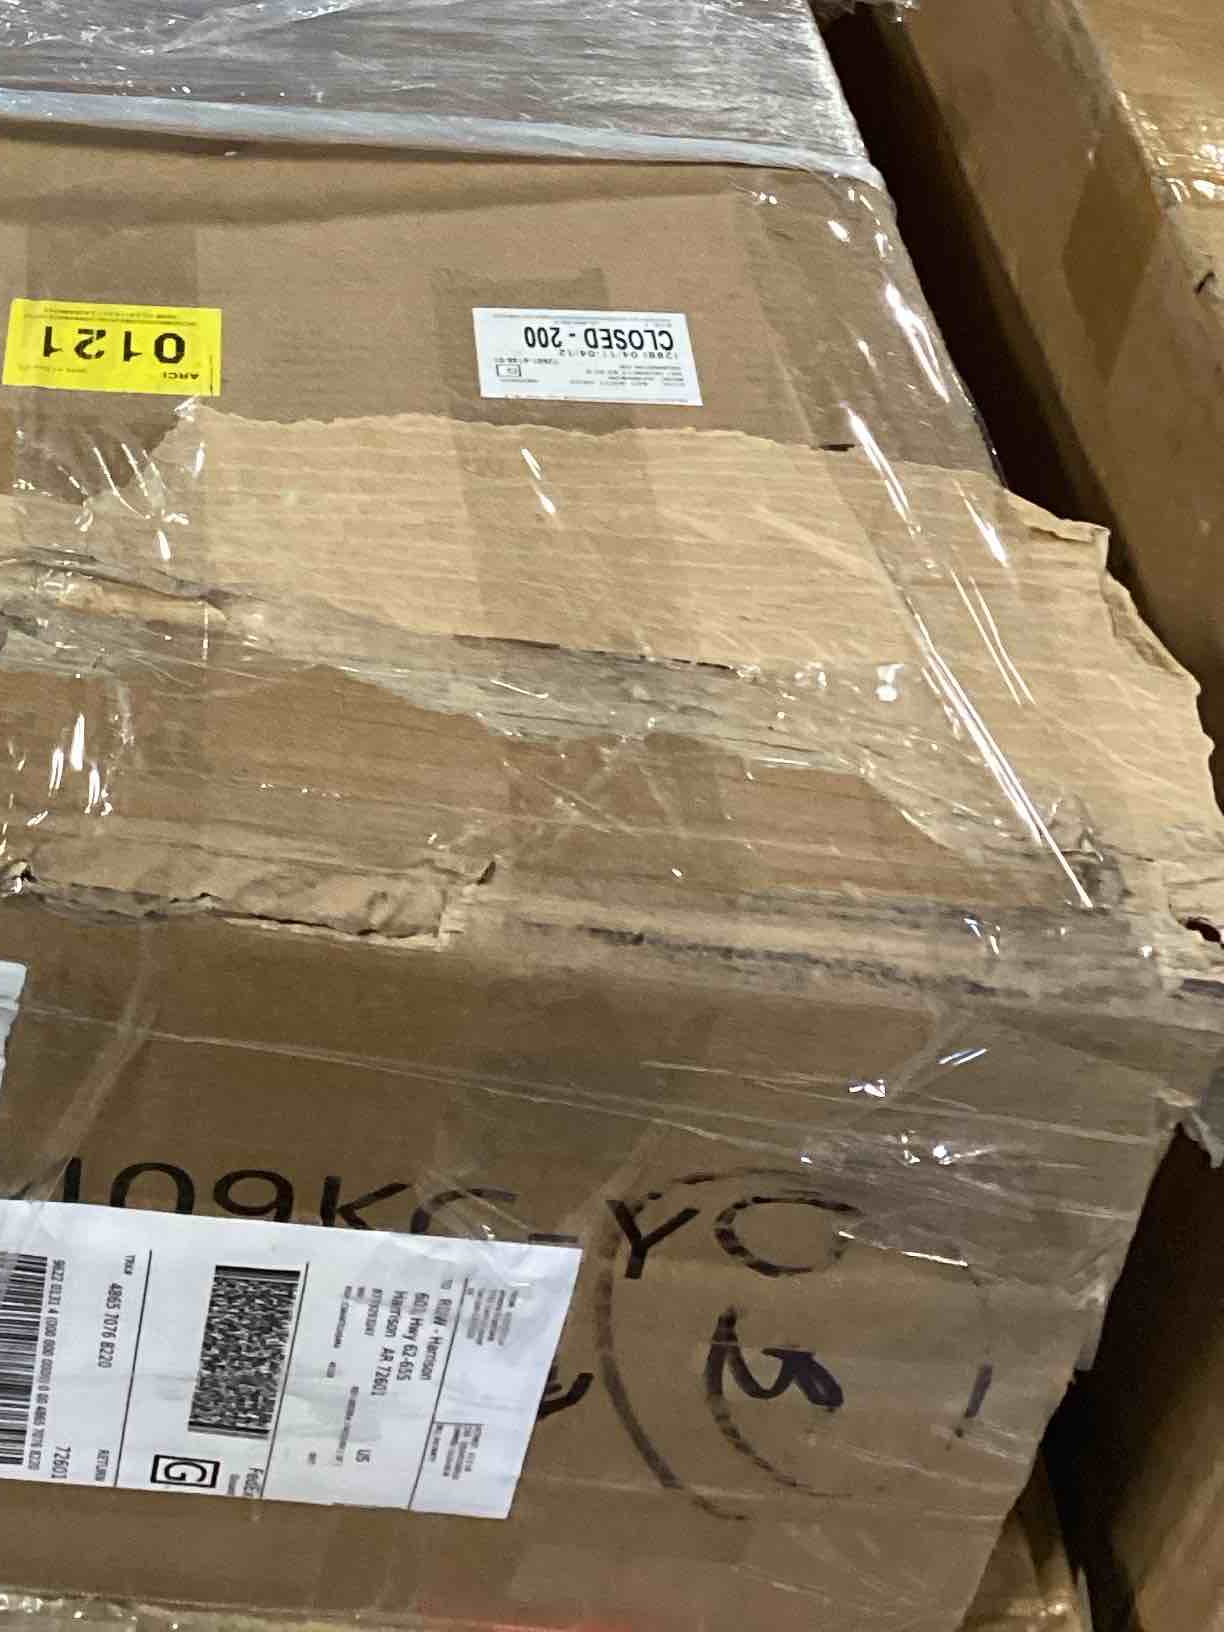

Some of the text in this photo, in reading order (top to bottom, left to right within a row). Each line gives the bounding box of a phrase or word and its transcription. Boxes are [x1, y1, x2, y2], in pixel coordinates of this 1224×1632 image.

[42, 325, 186, 365] 0121
[524, 325, 563, 350] 200
[584, 327, 675, 352] CLOSED
[101, 1314, 120, 1339] 7076
[401, 1317, 424, 1342] Hwy
[97, 1341, 115, 1368] 8220
[371, 1290, 407, 1396] Harrison AR 72601
[419, 1336, 444, 1381] Harrison
[51, 1447, 71, 1479] 72601
[355, 1449, 371, 1463] US
[164, 1462, 207, 1482] G
